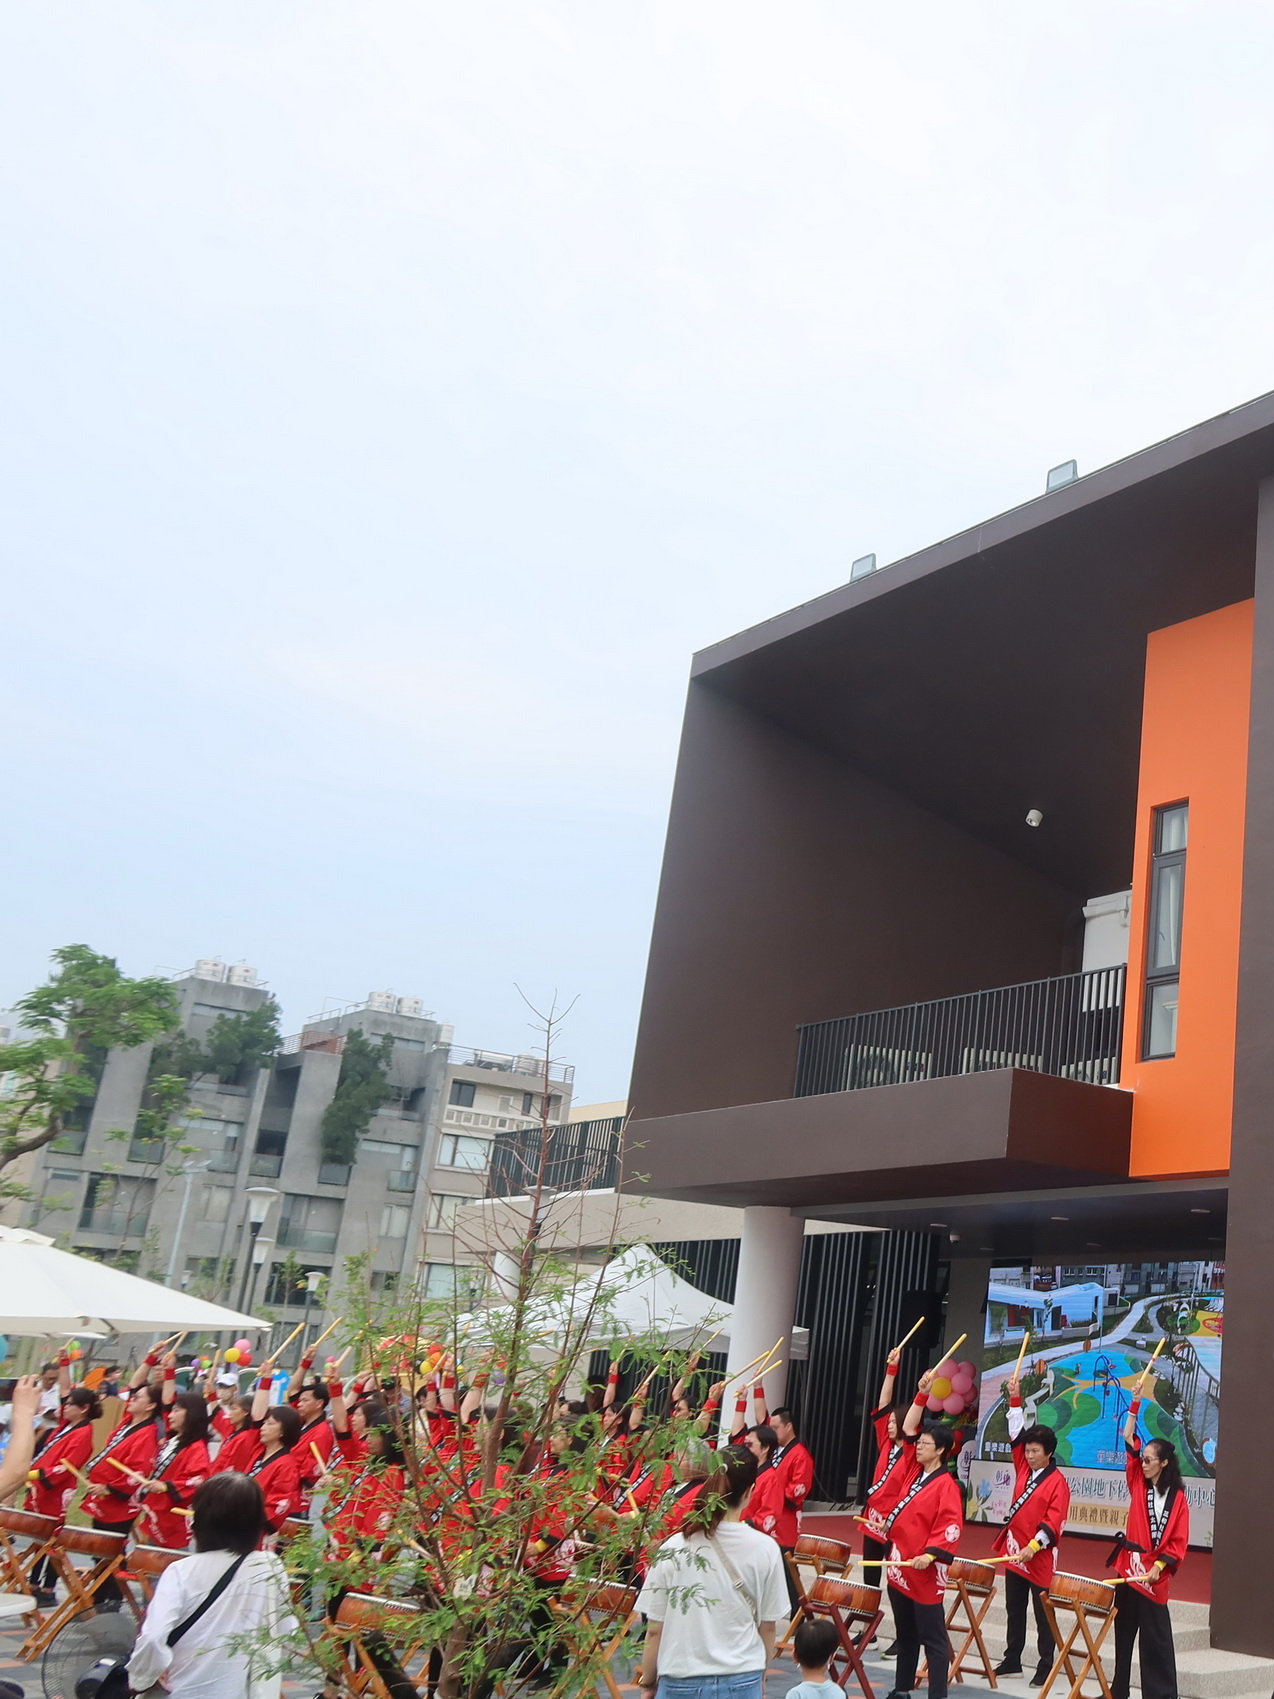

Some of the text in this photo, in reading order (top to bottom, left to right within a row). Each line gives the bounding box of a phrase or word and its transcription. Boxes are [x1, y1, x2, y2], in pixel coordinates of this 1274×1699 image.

[1096, 1449, 1128, 1465] 童樂遊
[1067, 1477, 1129, 1500] 公園地下停
